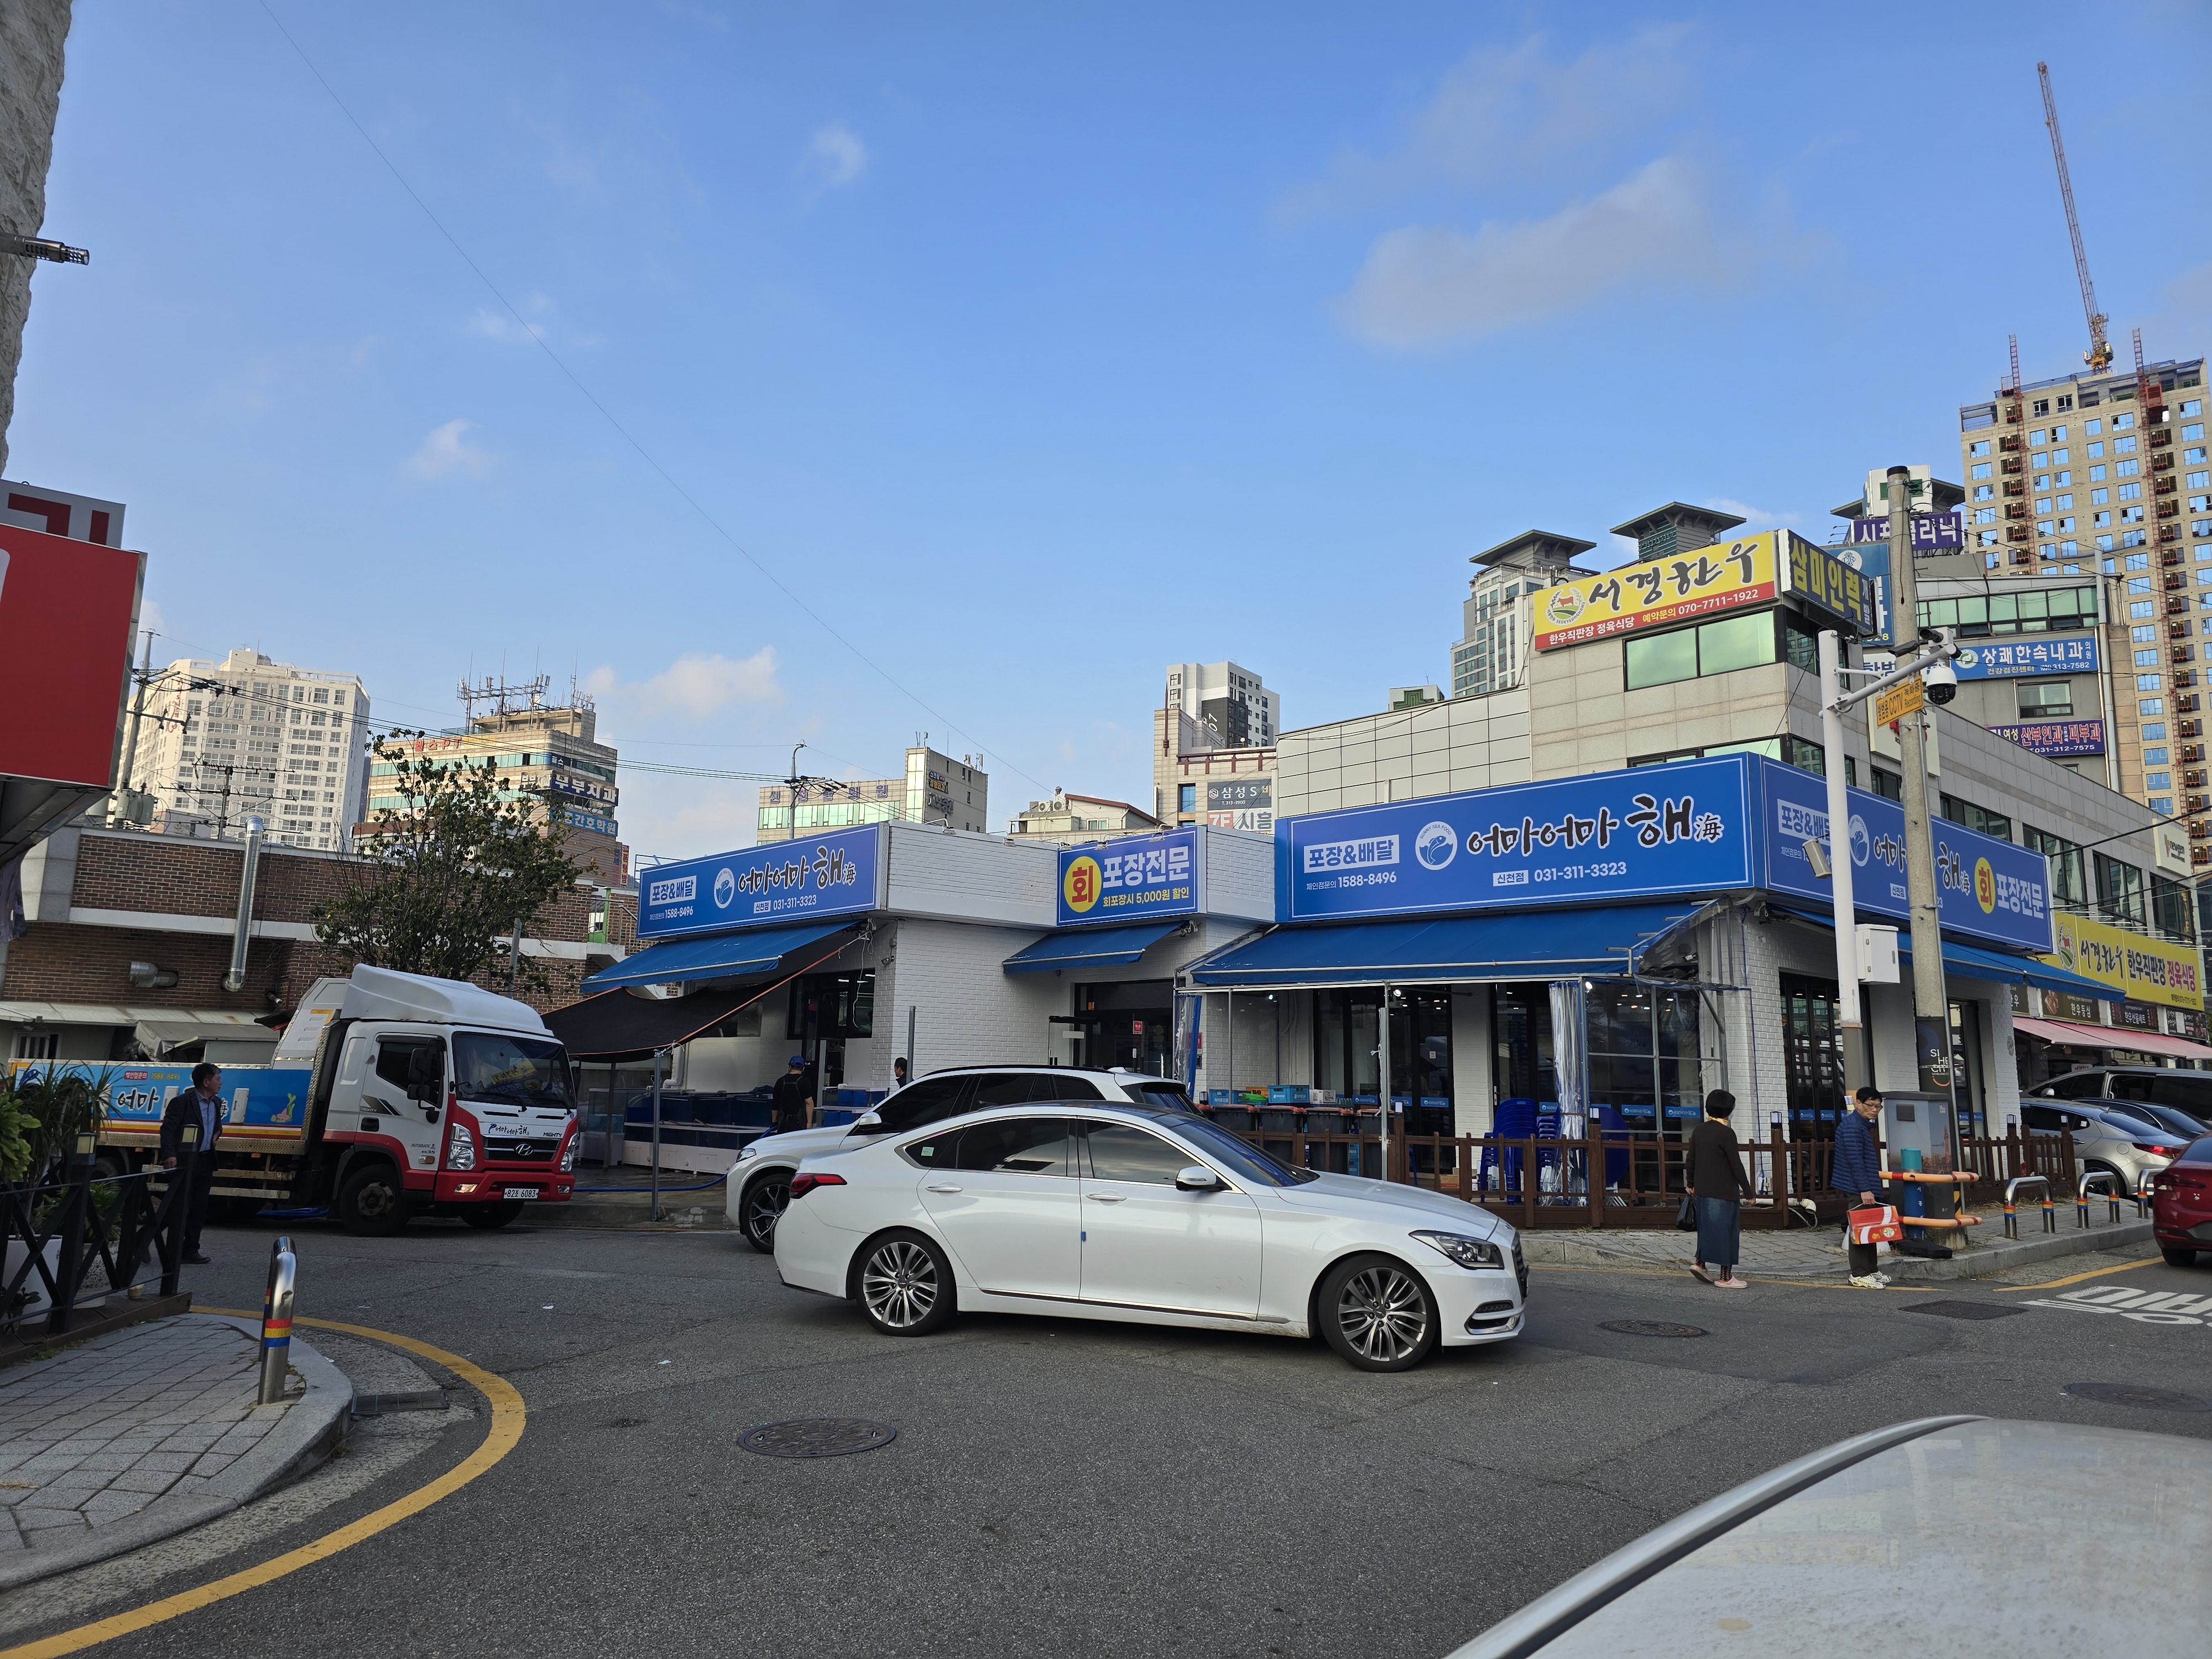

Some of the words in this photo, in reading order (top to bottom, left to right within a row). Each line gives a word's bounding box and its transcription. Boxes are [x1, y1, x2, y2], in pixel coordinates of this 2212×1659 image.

[1860, 517, 1956, 545] 시리닉
[1589, 542, 1757, 611] 서경한우
[1790, 538, 1863, 622] 삼미인력
[1549, 623, 1594, 645] 한우직판장
[1597, 614, 1634, 634] 정육식당
[1642, 607, 1676, 623] 예약문의
[1678, 589, 1759, 615] 070-7711-1922
[1987, 666, 2034, 675] 건강검진센터
[1904, 682, 1920, 696] 녹화중
[1878, 700, 1888, 721] 방범용
[1889, 692, 1903, 716] CCTV
[1905, 694, 1921, 708] Recording
[2021, 725, 2063, 746] 산부인과
[2069, 723, 2100, 743] 피부과
[555, 774, 617, 803] 부부치과
[1420, 826, 1431, 839] SUNNY
[1441, 825, 1452, 835] FOOD
[1468, 807, 1617, 857] 어마어마
[1308, 839, 1395, 869] 포장&배달
[1781, 846, 1802, 859] 체인점문의
[2170, 841, 2184, 856] newgen
[738, 855, 809, 895] 어마어마
[1072, 865, 1093, 904] 회
[1103, 846, 1190, 888] 포장전문
[1306, 880, 1337, 891] 체인점문의
[1338, 871, 1397, 888] 1588-8496
[1497, 873, 1525, 885] 신천점
[1535, 862, 1627, 883] 031-311-3323
[652, 879, 693, 902] 포장&배달
[1103, 894, 1134, 907] 회포장시
[1136, 889, 1170, 904] 5,000원
[1172, 886, 1189, 900] 할인
[1892, 886, 1904, 898] 신천점
[1978, 866, 1992, 906] 회
[1996, 873, 2044, 919] 포장전문
[665, 906, 693, 919] 1588-8496
[755, 902, 769, 911] 신천점
[773, 895, 816, 910] 031-311-3323
[2081, 940, 2124, 979] 서경한우
[2127, 949, 2166, 986] 한우직판장
[2167, 961, 2195, 992] 정육식당
[2070, 1003, 2091, 1018] 한우등심
[2125, 1011, 2146, 1024] 한우선물세트
[1930, 1048, 1939, 1057] SI
[521, 1190, 535, 1198] 6083
